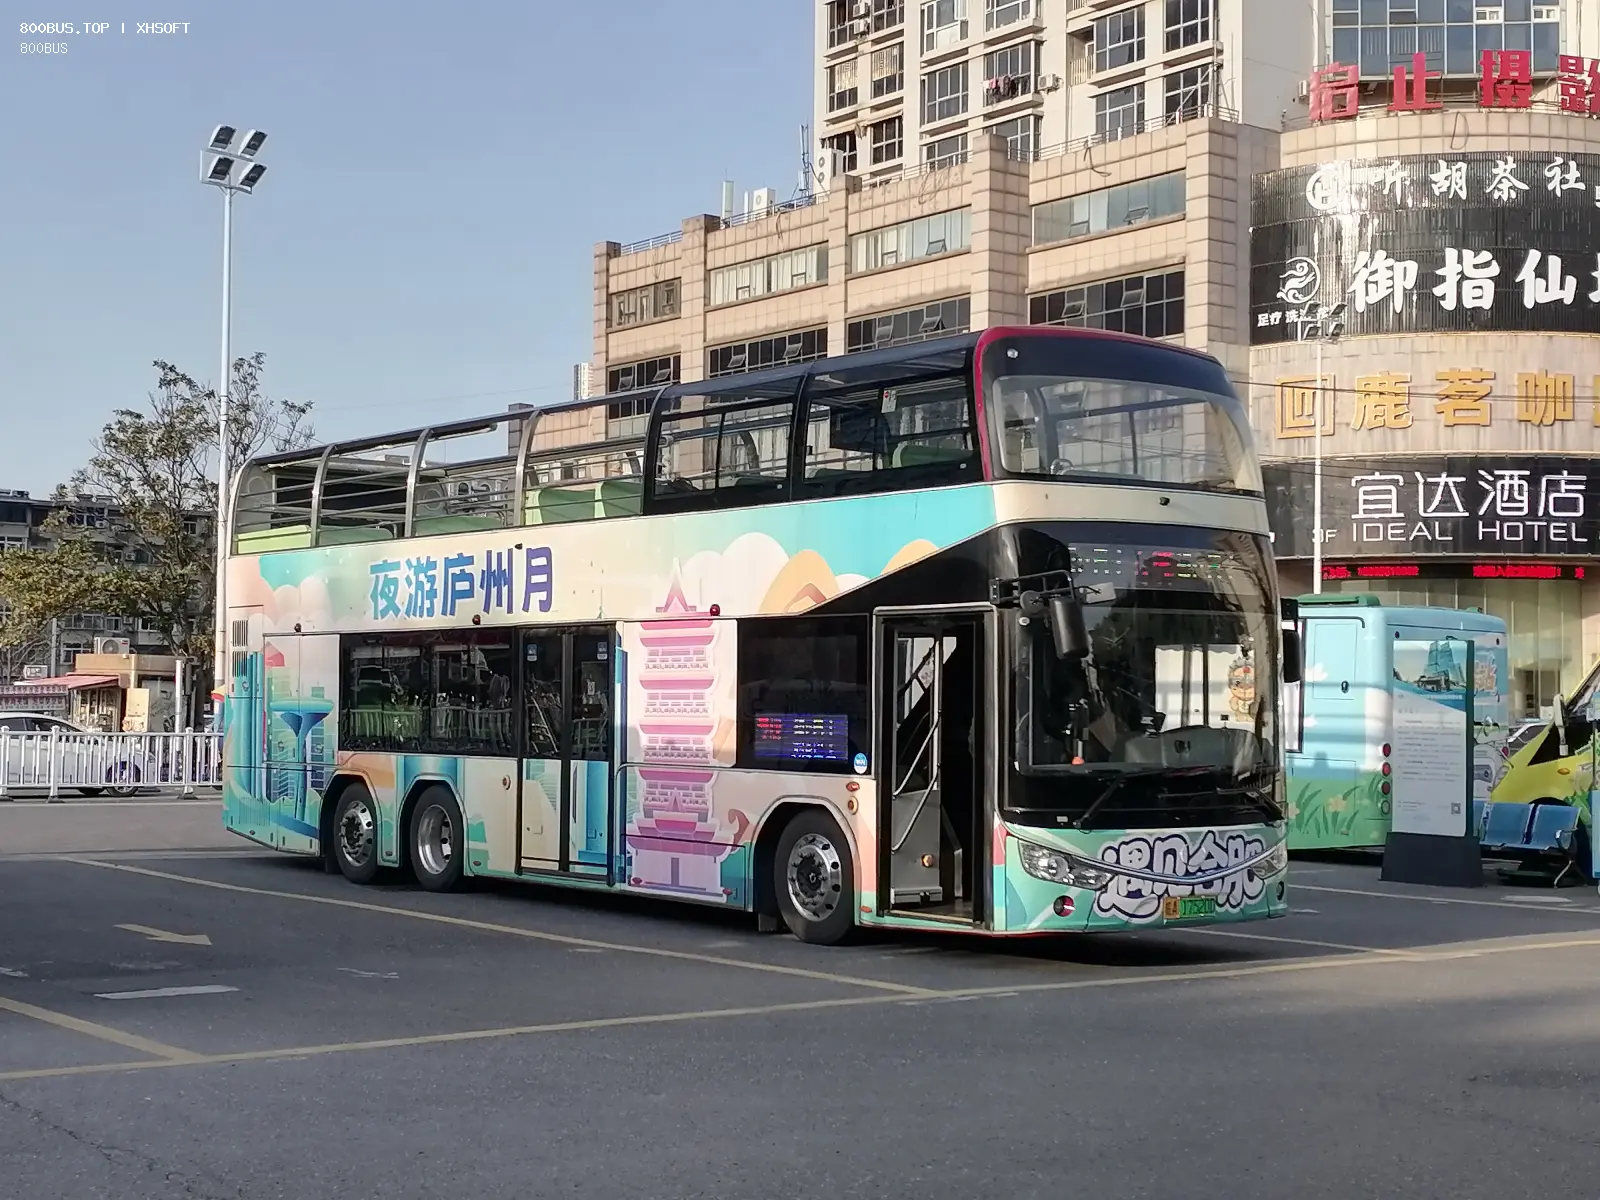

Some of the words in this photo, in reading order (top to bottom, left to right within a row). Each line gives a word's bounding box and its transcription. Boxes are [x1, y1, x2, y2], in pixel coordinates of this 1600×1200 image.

[1347, 248, 1600, 313] 御指仙
[1351, 470, 1587, 518] 宜达酒店
[1352, 521, 1453, 543] IDEAL
[1478, 520, 1588, 543] HOTEL
[369, 546, 553, 620] 夜游庐州月
